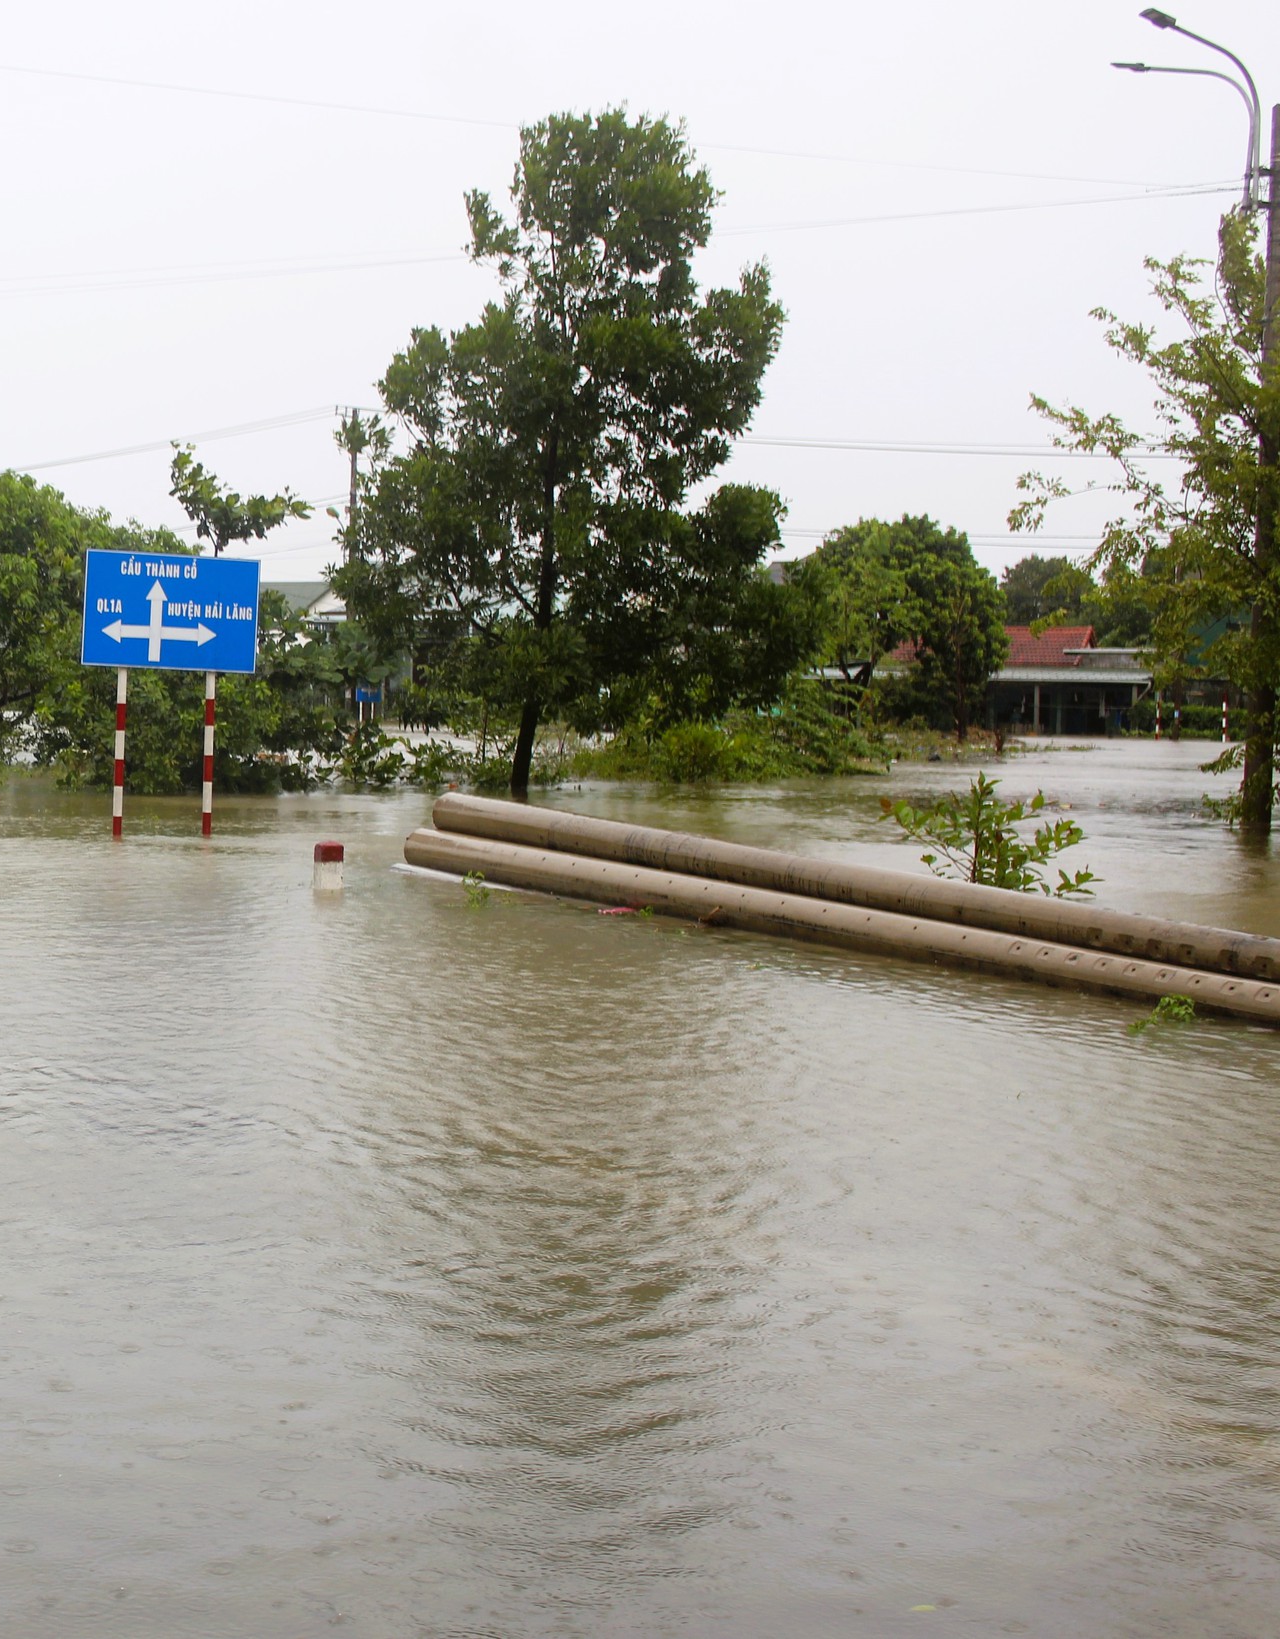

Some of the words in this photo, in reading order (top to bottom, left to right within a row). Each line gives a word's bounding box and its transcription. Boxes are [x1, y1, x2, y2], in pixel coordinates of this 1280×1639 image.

[120, 555, 141, 576] CẦU
[145, 559, 180, 578] THÀNH
[97, 598, 122, 614] QL1A
[168, 600, 200, 620] HUYỆN
[226, 603, 252, 620] LĂNG
